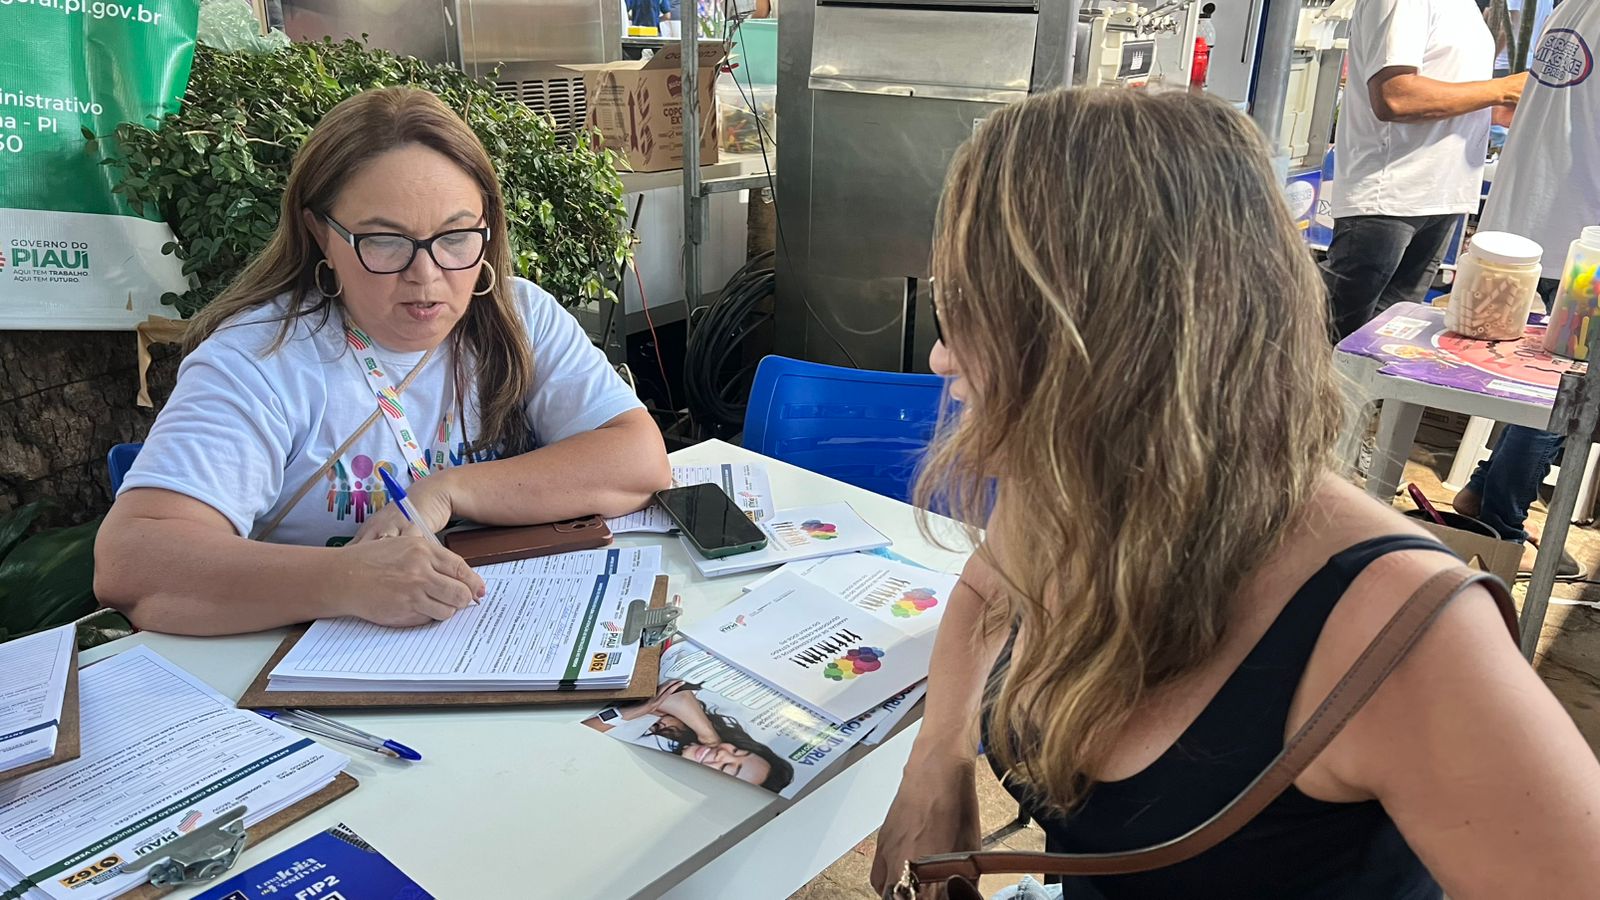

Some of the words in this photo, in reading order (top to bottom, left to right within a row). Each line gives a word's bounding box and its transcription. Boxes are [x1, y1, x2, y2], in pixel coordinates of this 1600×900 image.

[38, 116, 57, 133] PI
[11, 239, 68, 248] GOVERNO
[72, 242, 88, 250] DO
[590, 658, 604, 671] 162
[62, 848, 91, 867] VERSO
[61, 862, 102, 889] 162
[294, 875, 340, 900] FIP2
